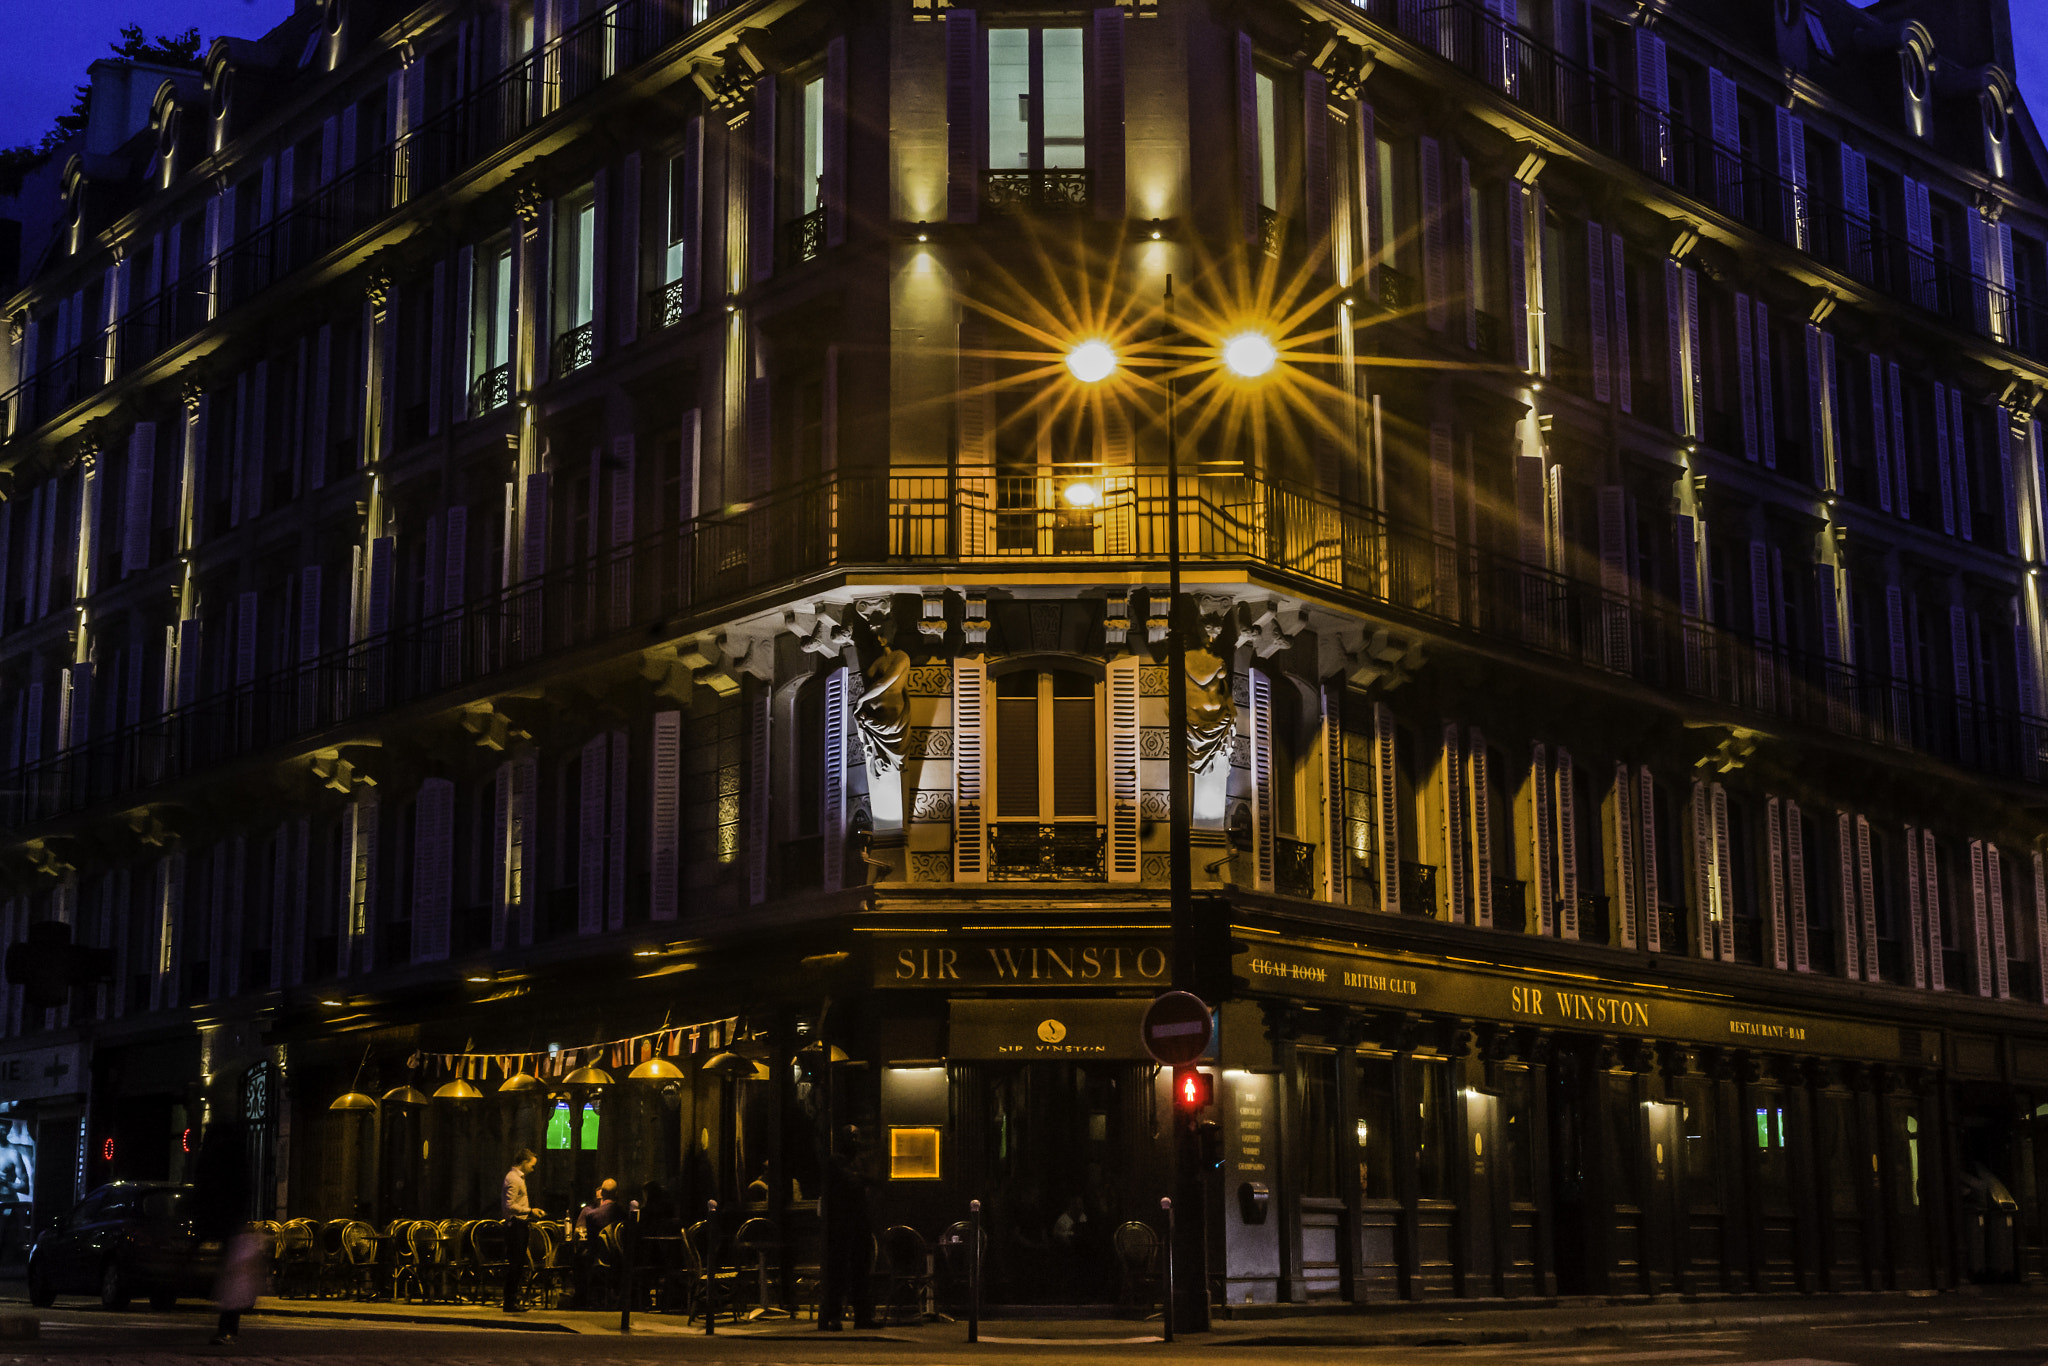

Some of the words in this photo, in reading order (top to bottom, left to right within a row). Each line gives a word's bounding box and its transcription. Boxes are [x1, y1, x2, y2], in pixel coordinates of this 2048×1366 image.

[895, 948, 960, 980] SIR
[987, 946, 1167, 979] WINSTO
[1252, 958, 1287, 977] CIGAR
[1292, 964, 1326, 982] ROOM
[1343, 971, 1387, 991] BRITISH
[1389, 978, 1417, 995] CLUB
[1511, 986, 1544, 1015] SIR
[1556, 992, 1649, 1027] WINSTON
